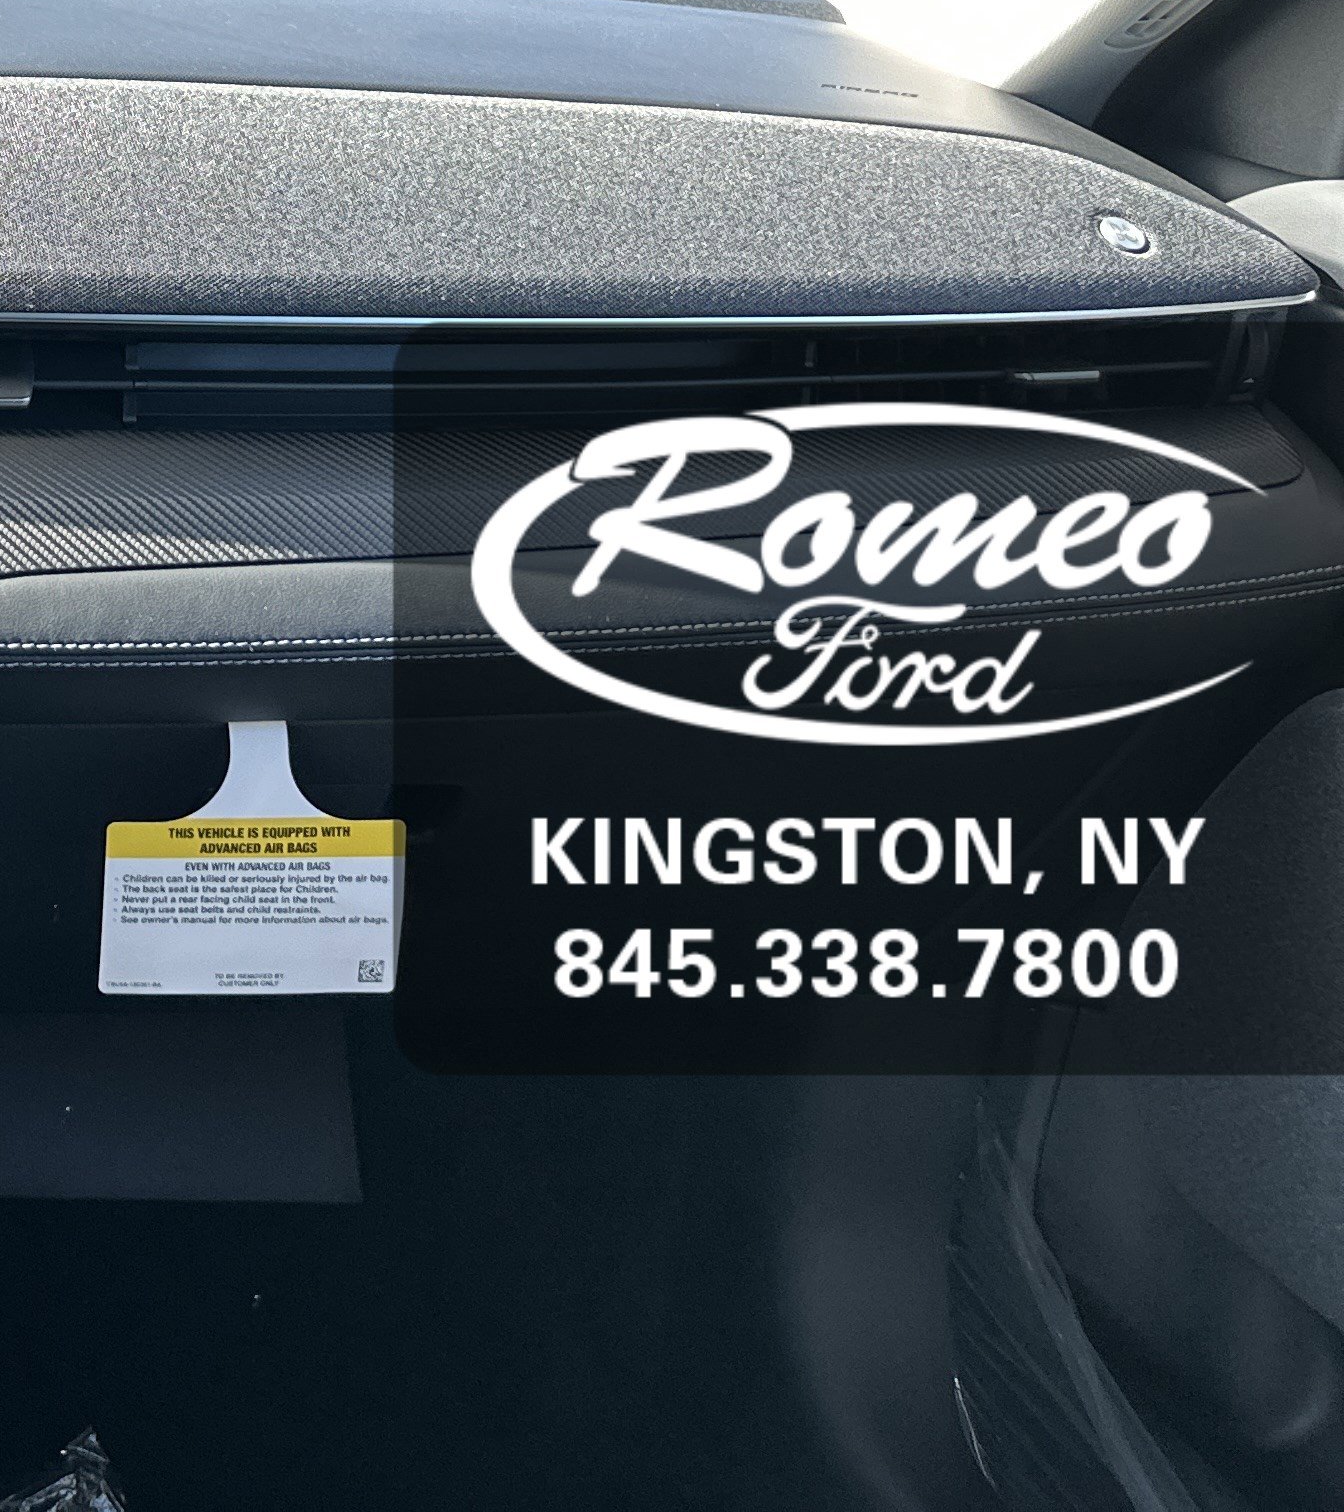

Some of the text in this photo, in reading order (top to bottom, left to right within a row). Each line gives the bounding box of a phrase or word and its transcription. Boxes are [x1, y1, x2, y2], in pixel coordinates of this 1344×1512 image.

[169, 826, 350, 838] THIS VEHICLE IS EQUIPPED WITH
[200, 843, 317, 854] ADVANCED AIR BAGS
[185, 862, 330, 871] EVEN WITH ADVANCED AIR BAGS
[123, 874, 163, 883] Children
[186, 875, 197, 883] be
[200, 874, 226, 883] killed
[241, 874, 285, 884] seriously
[288, 874, 321, 884] injured
[324, 875, 335, 884] by
[338, 875, 352, 883] the
[356, 875, 367, 883] air
[370, 874, 390, 884] bag.
[122, 885, 139, 893] The
[142, 885, 165, 893] back
[169, 885, 188, 893] seat
[202, 885, 217, 893] the
[220, 885, 248, 893] safest
[251, 885, 277, 895] place
[280, 885, 292, 893] for
[296, 885, 338, 894] Children.
[122, 895, 149, 903] Never
[152, 896, 167, 905] put
[201, 895, 229, 905] facing
[232, 895, 255, 903] child
[258, 895, 278, 903] seat
[281, 895, 290, 903] in
[293, 895, 307, 903] the
[310, 895, 335, 903] front.
[122, 906, 155, 915] Always
[121, 916, 138, 924] See
[141, 916, 178, 924] owner's
[181, 916, 216, 924] manual
[219, 916, 232, 924] for
[262, 916, 316, 924] information
[319, 916, 345, 924] about
[363, 916, 389, 925] bags.
